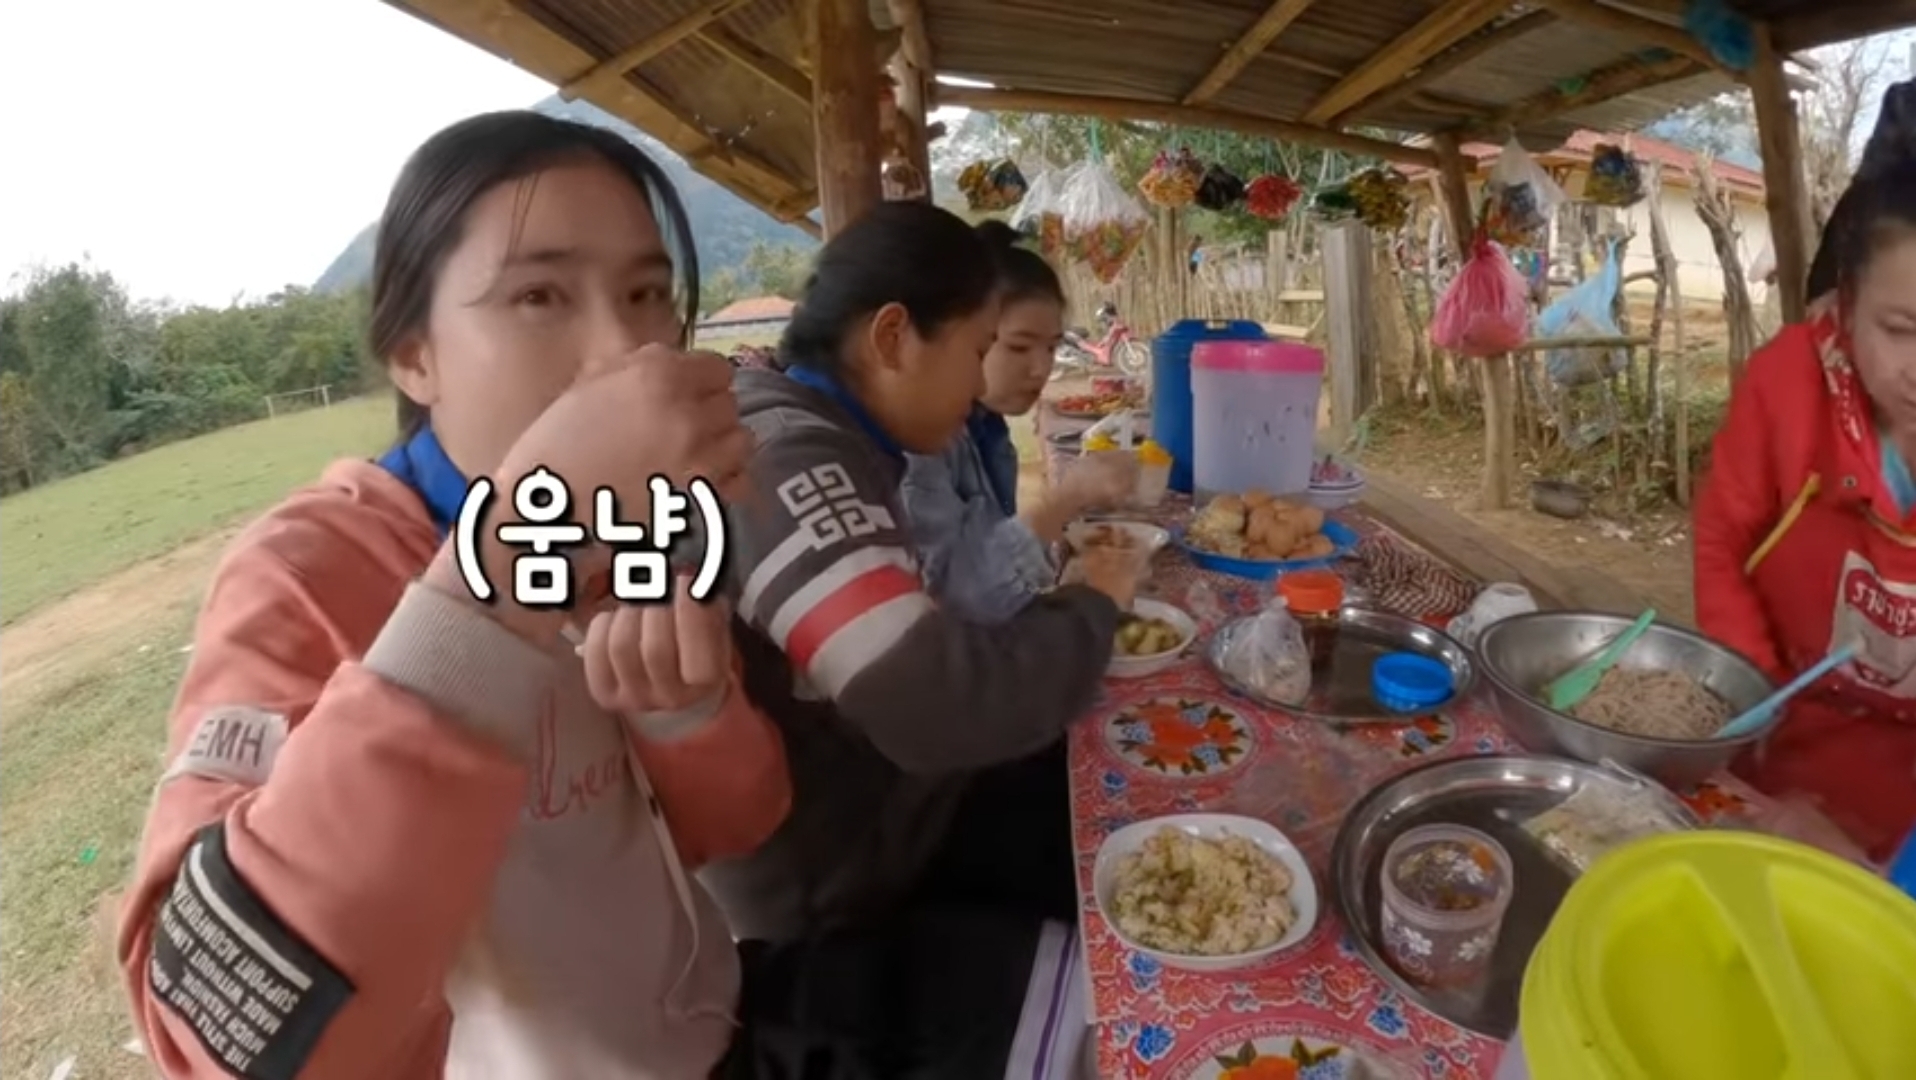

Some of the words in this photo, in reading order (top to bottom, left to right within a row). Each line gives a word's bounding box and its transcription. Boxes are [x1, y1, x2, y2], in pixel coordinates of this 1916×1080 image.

[189, 948, 244, 1004] WITHOUT
[234, 955, 299, 1013] SUPPORT
[241, 996, 283, 1035] MADE
[226, 1017, 267, 1054] MUCH
[224, 1045, 252, 1072] THE
